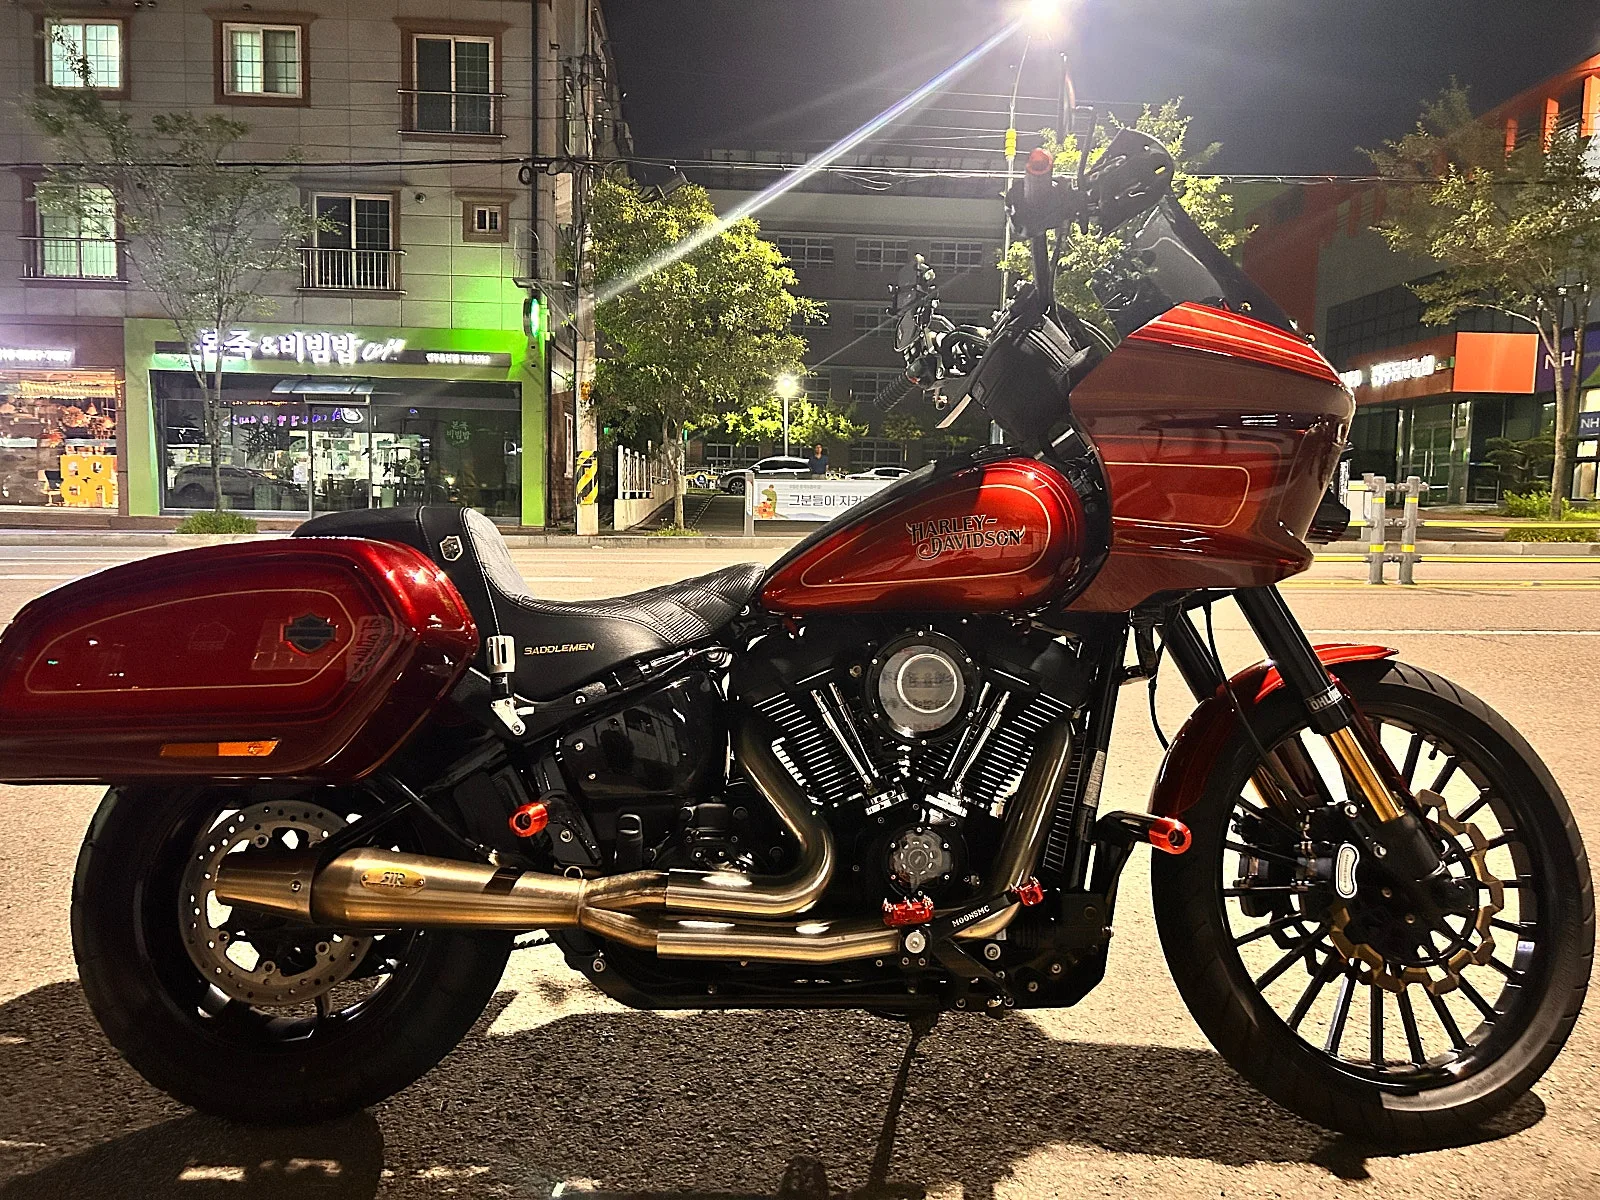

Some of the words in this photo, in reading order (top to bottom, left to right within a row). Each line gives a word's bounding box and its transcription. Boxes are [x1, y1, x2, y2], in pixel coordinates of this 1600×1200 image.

[1544, 350, 1575, 370] NH
[1580, 417, 1600, 429] NH
[446, 430, 471, 440] 비빔밥
[788, 494, 835, 507] 그분들이
[839, 494, 870, 507] 지키
[905, 514, 998, 546] HARLEY-
[916, 525, 1026, 561] DAVIDSON
[523, 642, 596, 656] SADDLEMEN
[951, 904, 991, 928] MOONSMC
